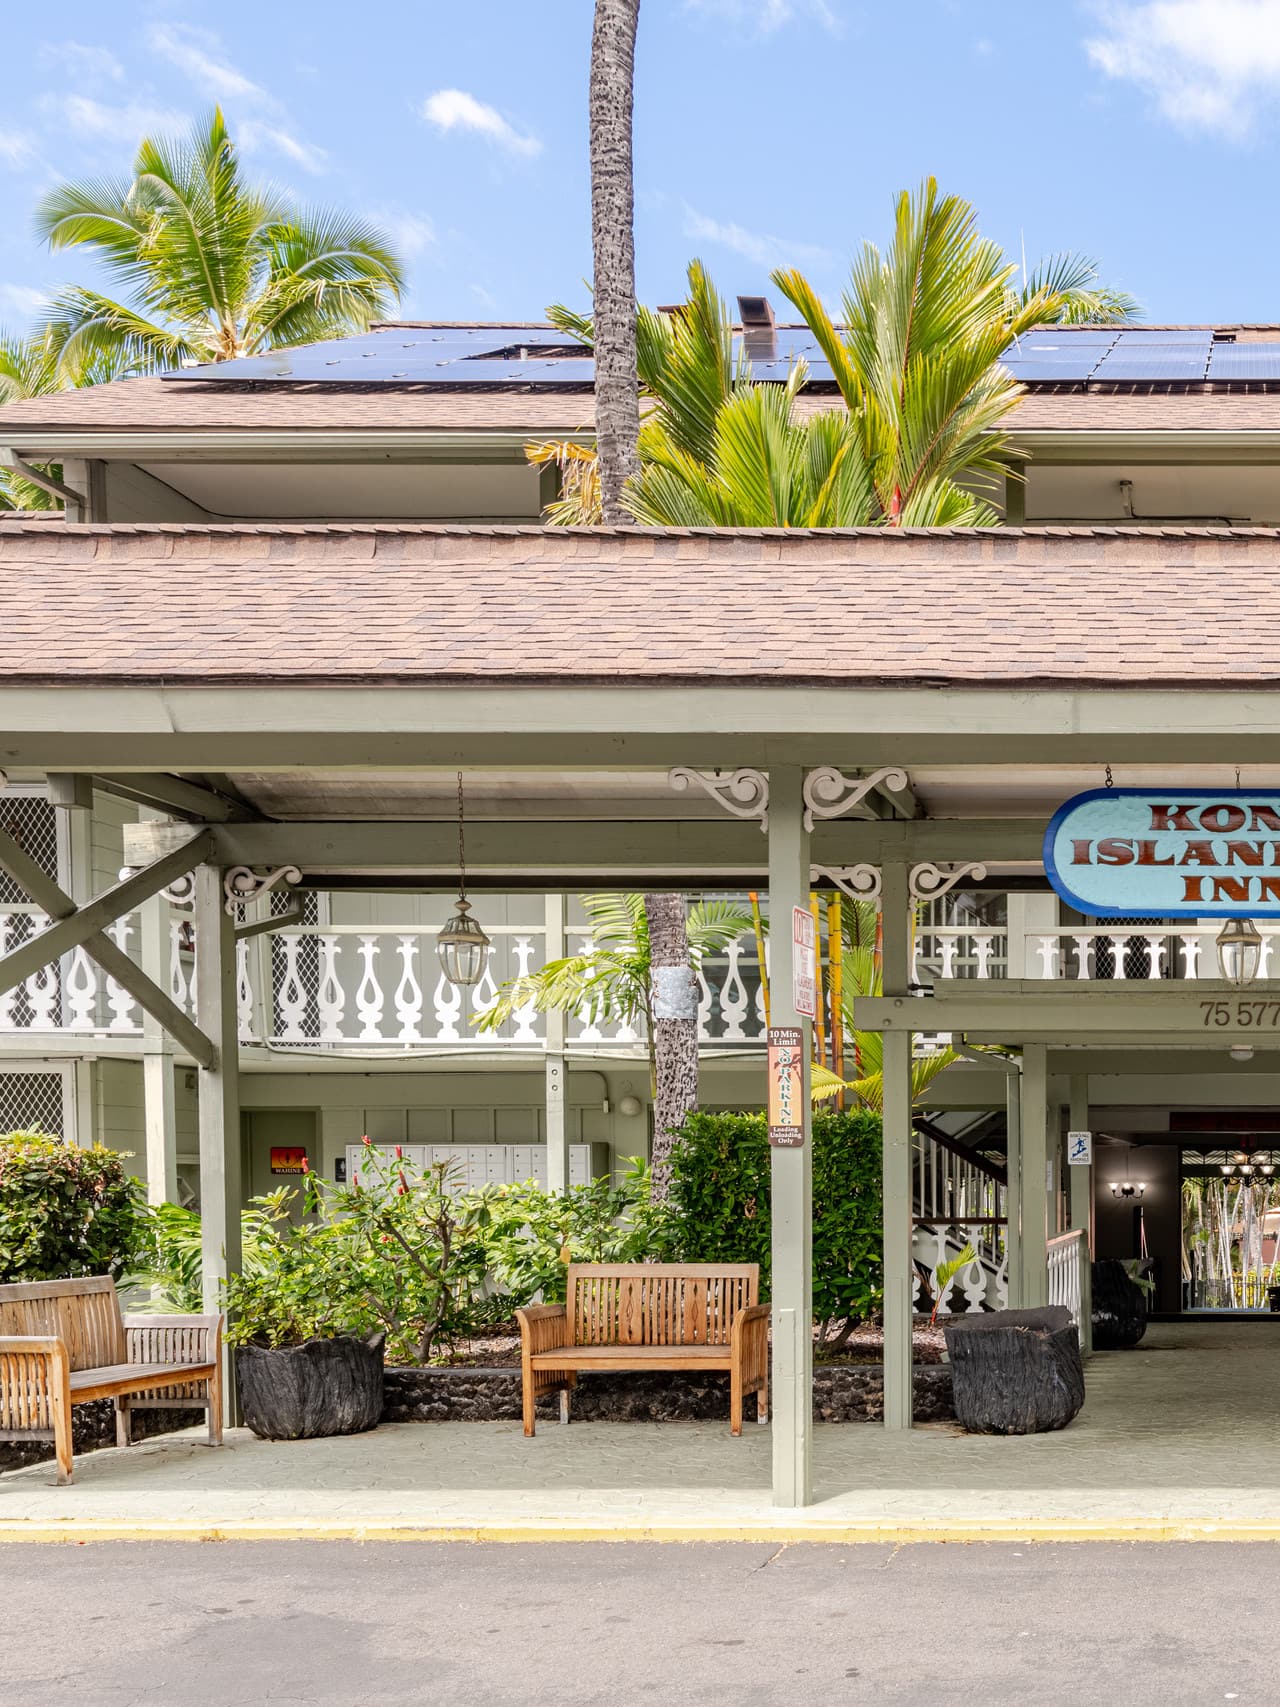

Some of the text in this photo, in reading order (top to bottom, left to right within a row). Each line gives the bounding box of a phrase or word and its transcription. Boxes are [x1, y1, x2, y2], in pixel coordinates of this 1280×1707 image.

[1200, 1002, 1230, 1026] 75
[769, 1030, 801, 1038] 10 Min.
[774, 1038, 797, 1046] Limit
[779, 1048, 792, 1125] NO PARKING
